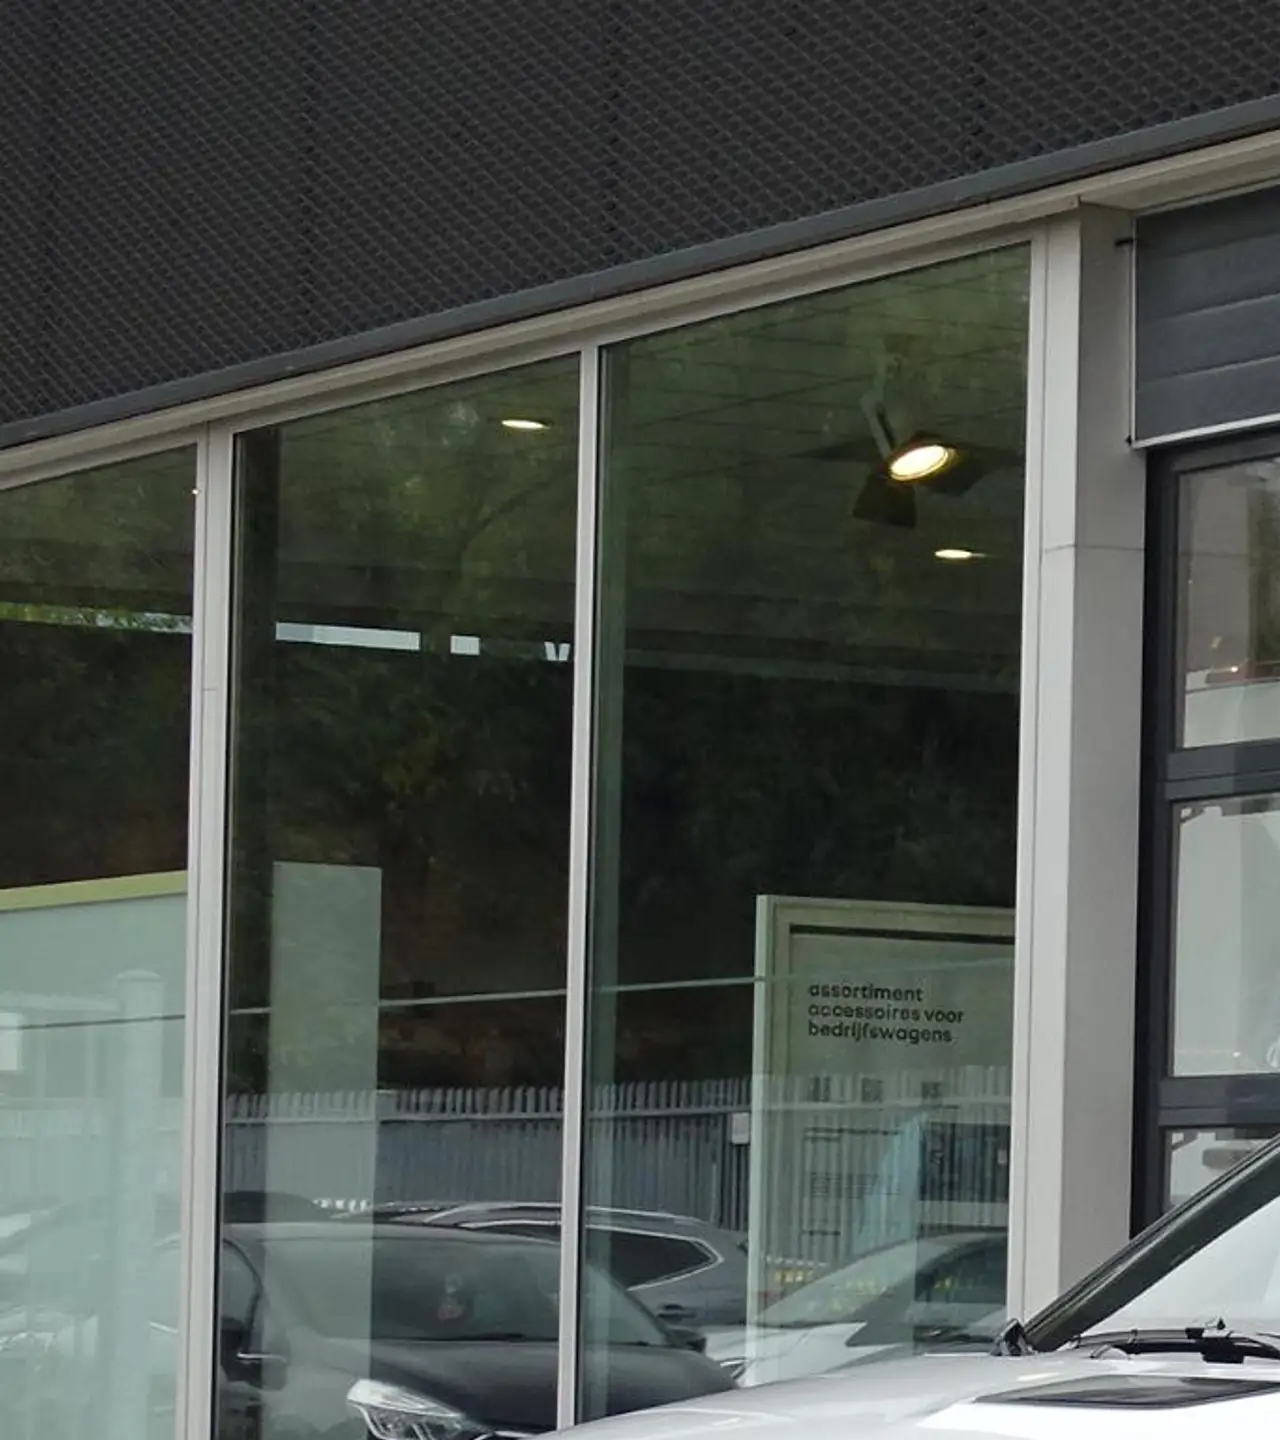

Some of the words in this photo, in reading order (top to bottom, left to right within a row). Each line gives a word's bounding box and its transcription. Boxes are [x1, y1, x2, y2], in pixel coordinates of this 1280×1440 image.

[809, 983, 923, 1001] assortiment
[808, 1003, 921, 1021] accessoires
[924, 1010, 965, 1024] voor
[808, 1021, 953, 1043] bedrijfswagens
